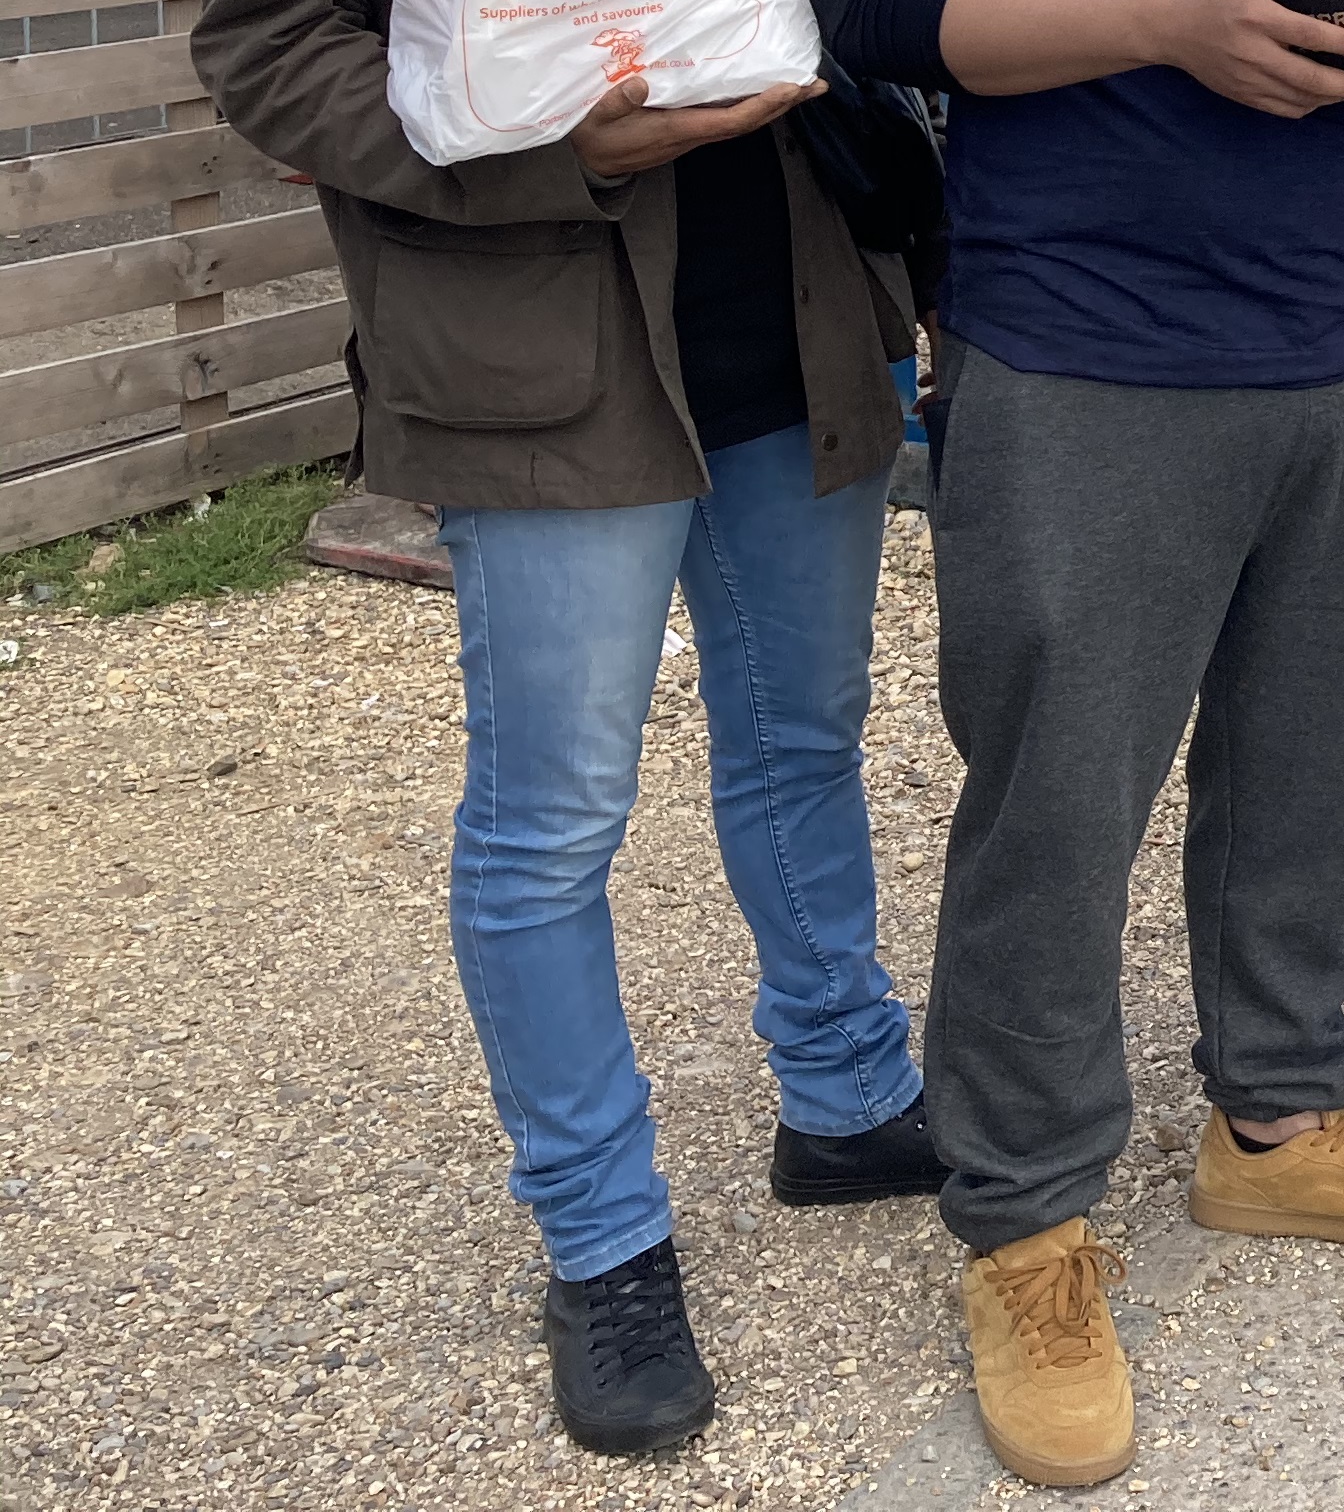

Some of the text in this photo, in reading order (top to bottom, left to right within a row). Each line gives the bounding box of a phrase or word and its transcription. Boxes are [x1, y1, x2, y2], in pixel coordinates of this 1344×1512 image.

[479, 3, 549, 21] Suppliers
[551, 3, 567, 16] of
[573, 10, 599, 26] and
[602, 2, 664, 22] savouries
